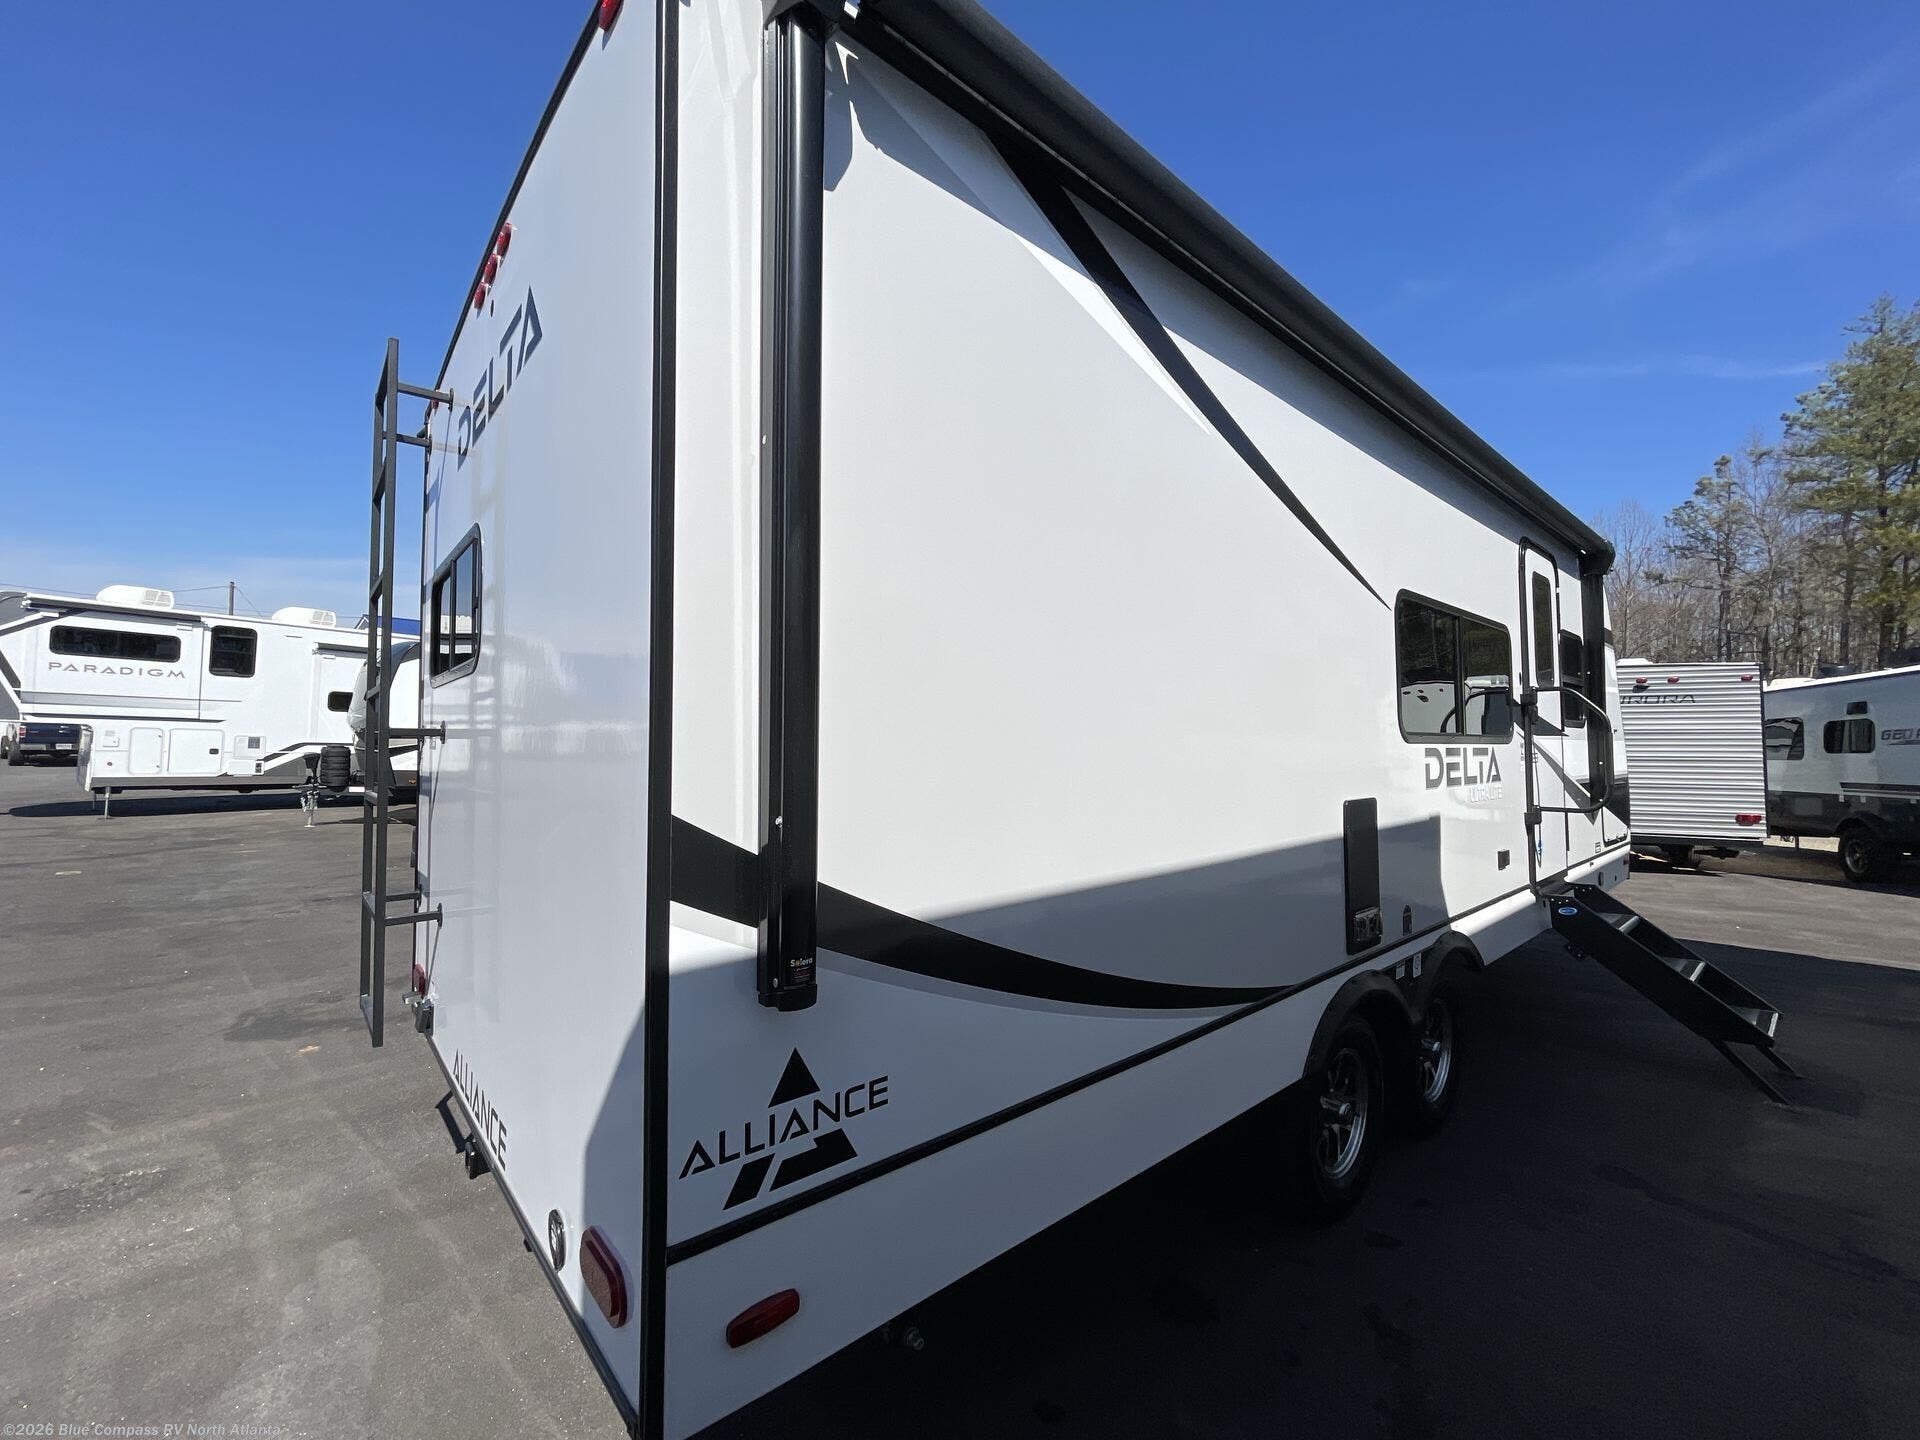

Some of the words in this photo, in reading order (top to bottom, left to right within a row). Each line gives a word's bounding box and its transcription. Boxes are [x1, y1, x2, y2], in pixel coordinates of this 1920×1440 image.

[457, 285, 543, 472] DELTA
[49, 661, 185, 679] PARADIGM
[1425, 747, 1501, 790] DELTA
[453, 1050, 507, 1171] ALLIANCE
[679, 1075, 889, 1180] ALLIANCE
